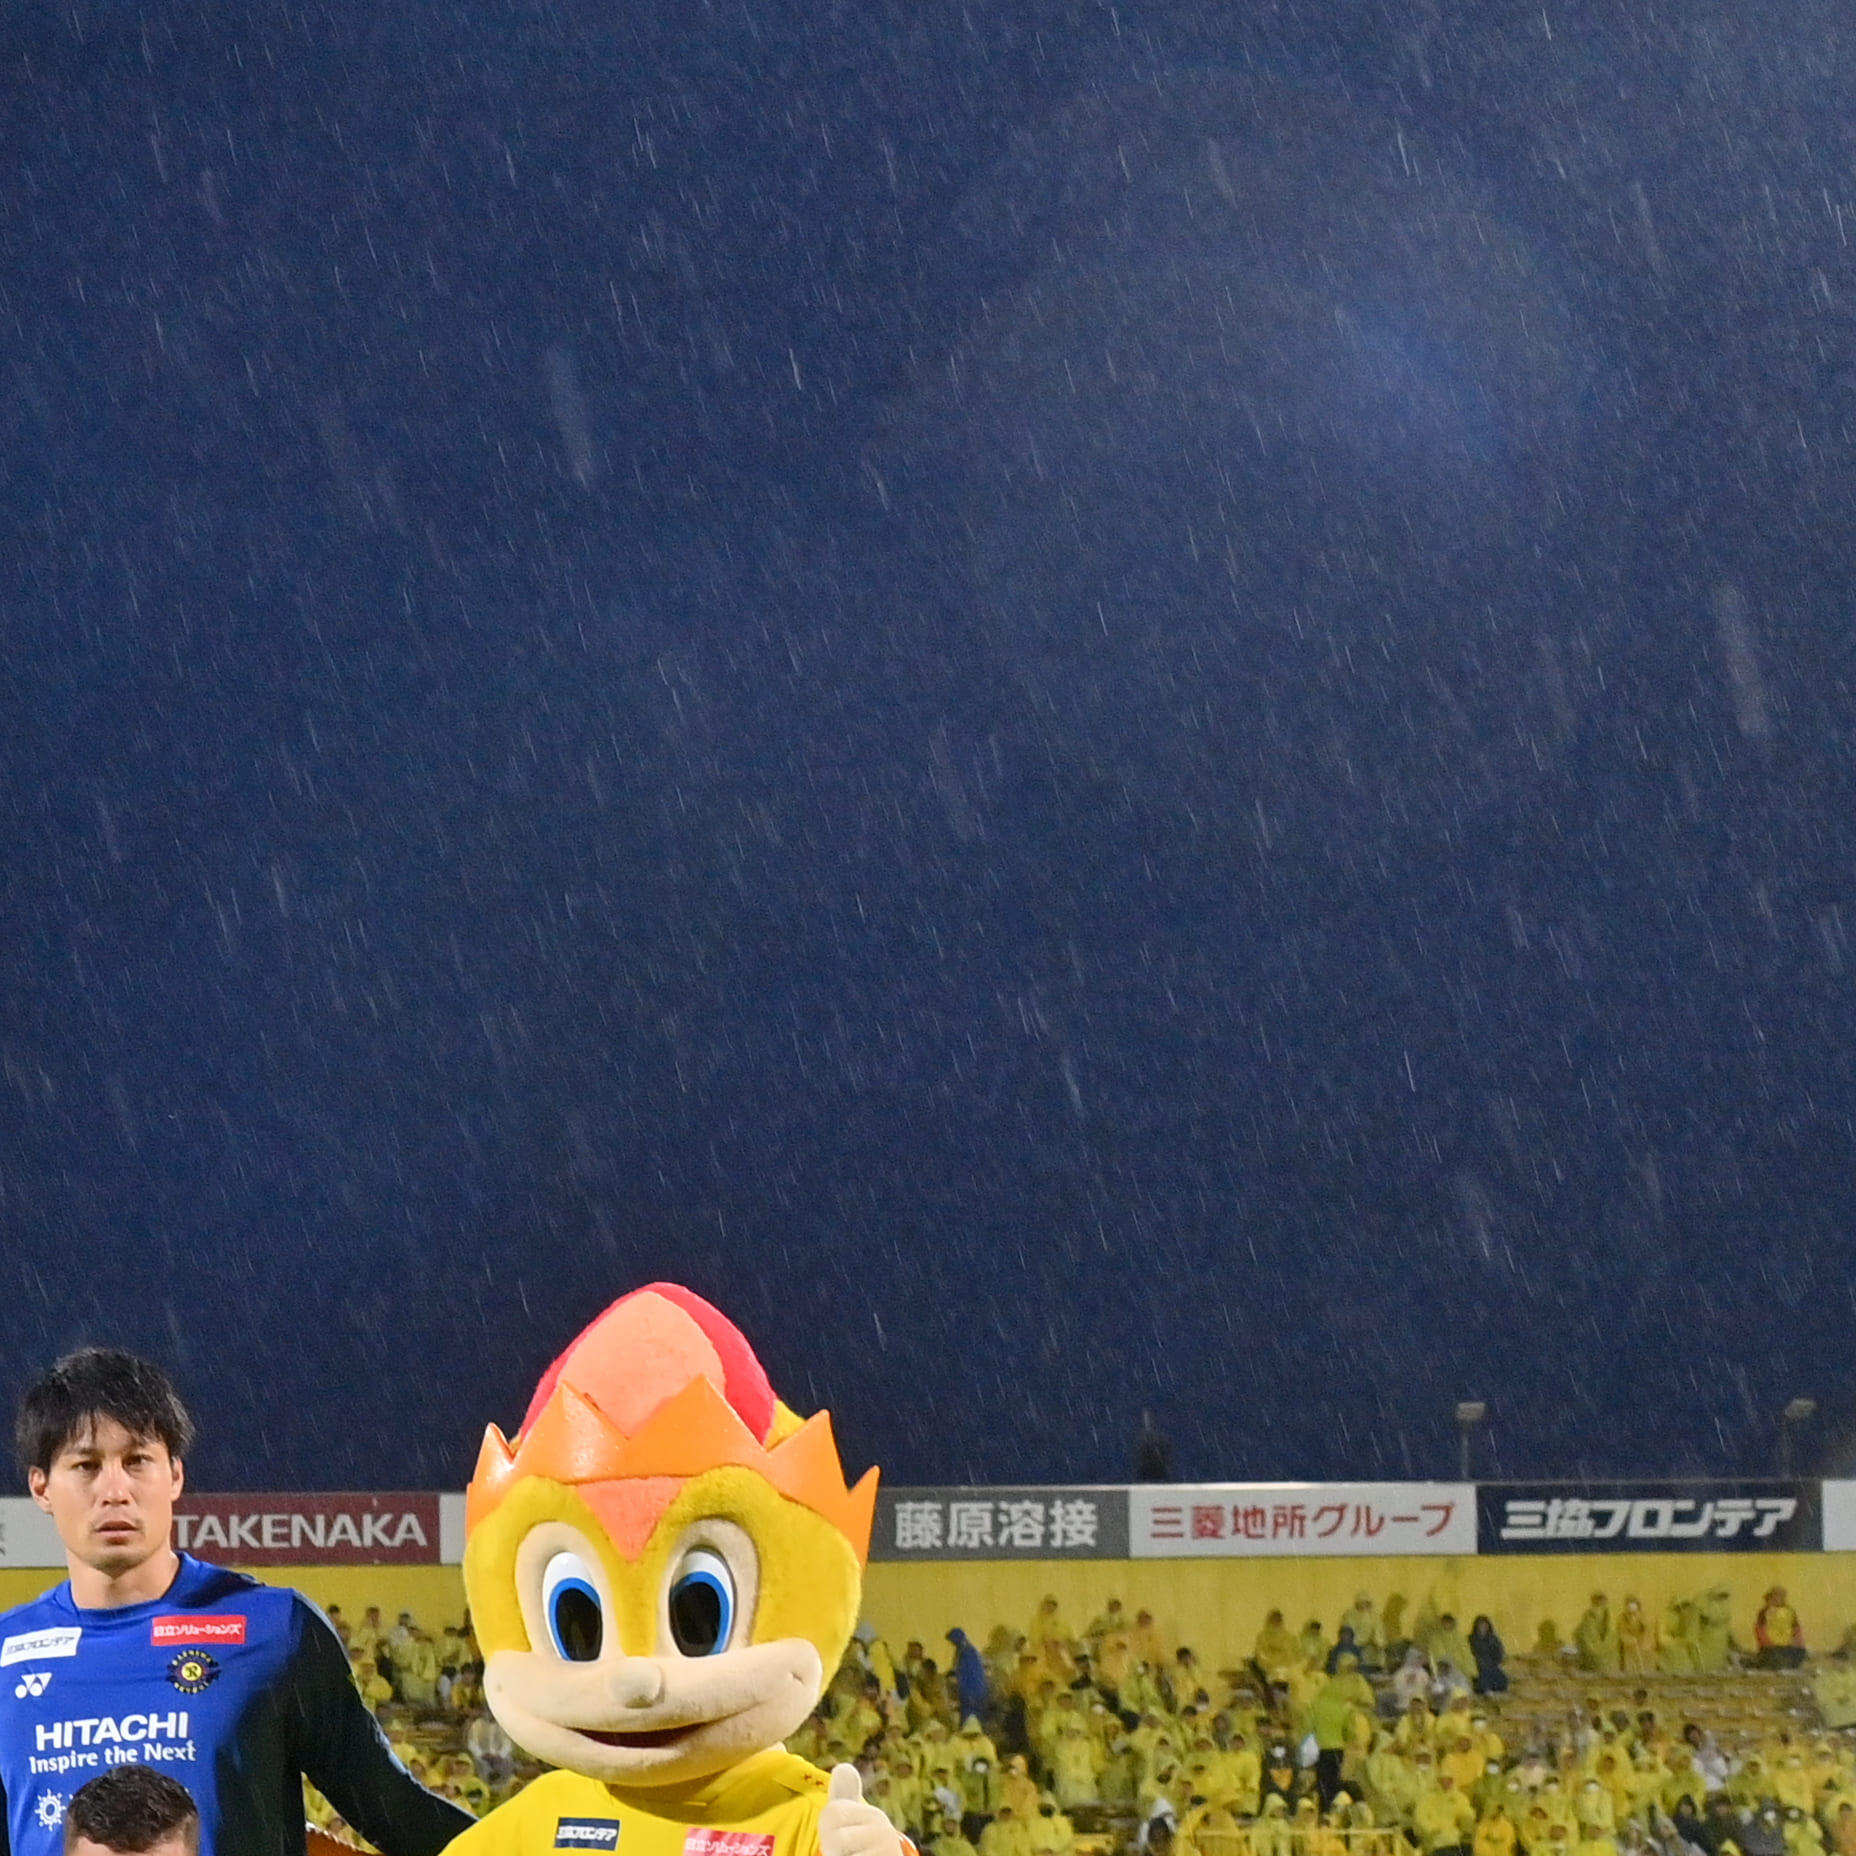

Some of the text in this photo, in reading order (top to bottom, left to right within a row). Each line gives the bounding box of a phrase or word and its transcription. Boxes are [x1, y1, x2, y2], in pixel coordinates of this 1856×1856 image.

[175, 1512, 428, 1550] TAKENAKA
[894, 1498, 1099, 1550] 藤原溶接
[1148, 1501, 1456, 1541] 三菱地所グループ
[1500, 1498, 1796, 1539] 三協フロンテア
[34, 1711, 189, 1751] HITACHI
[29, 1740, 197, 1775] Inspire the Next
